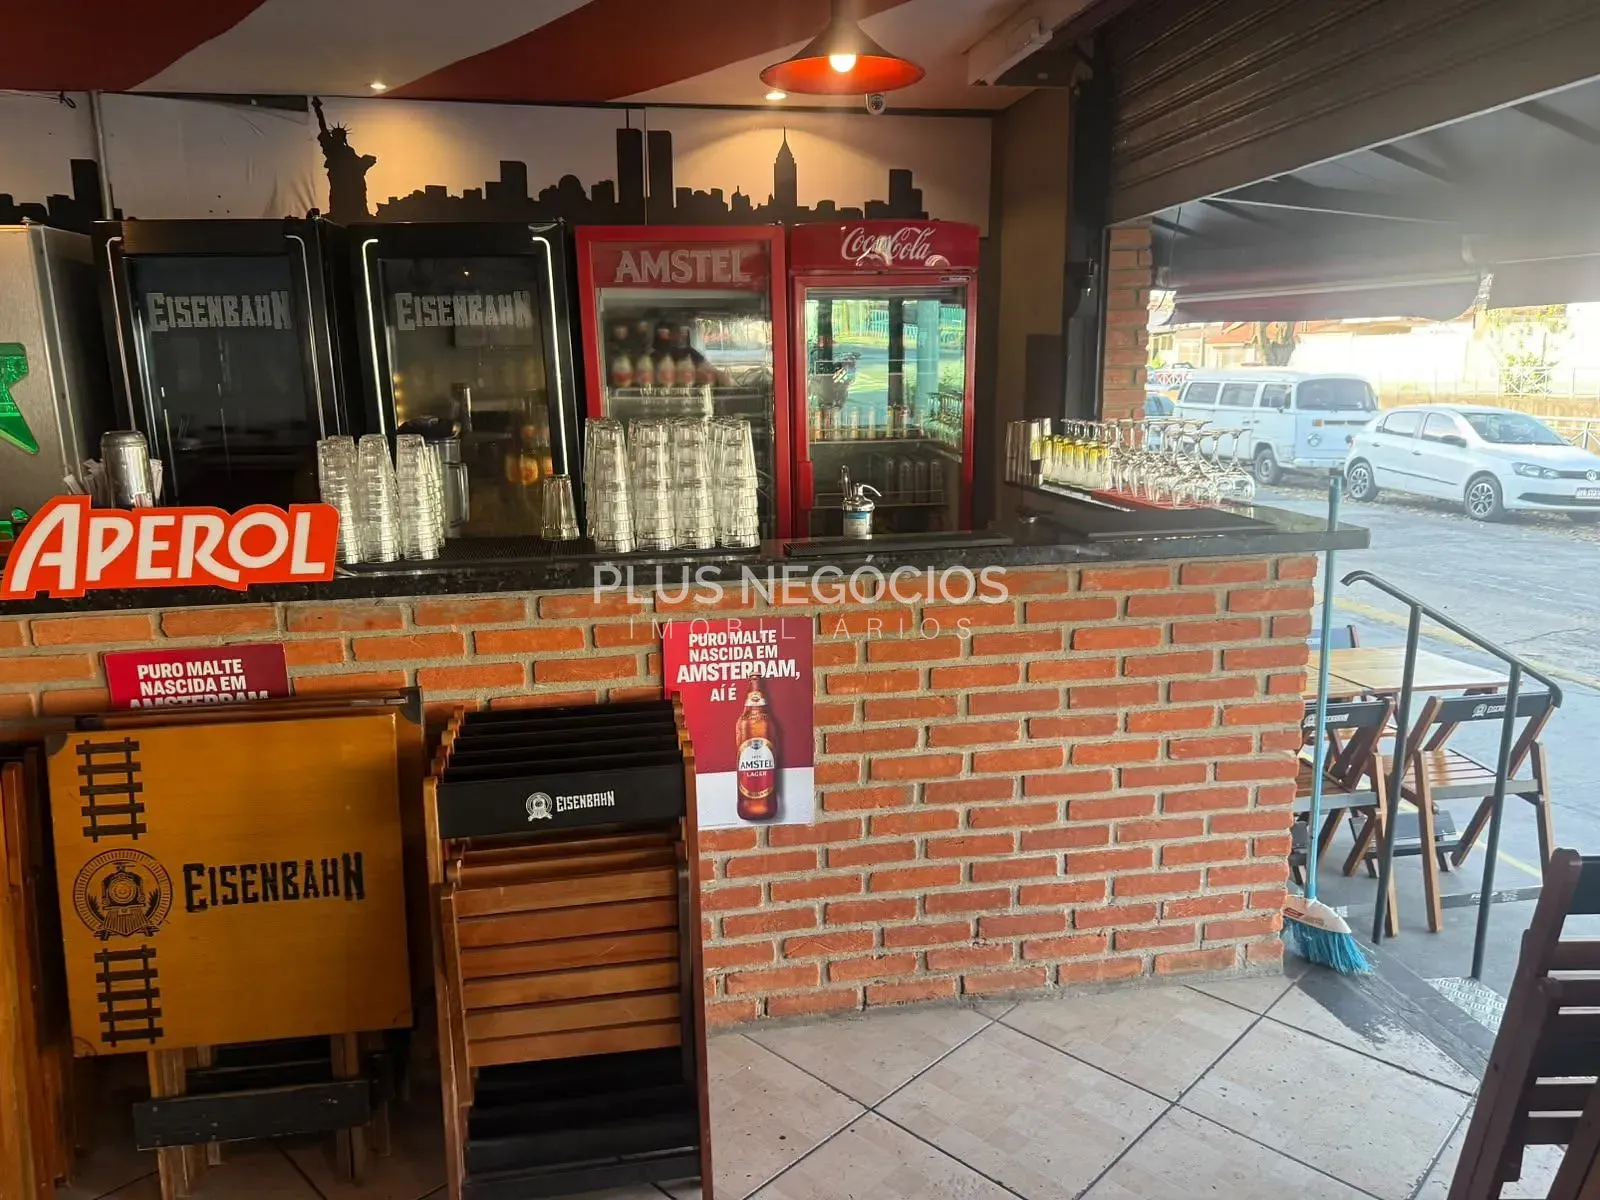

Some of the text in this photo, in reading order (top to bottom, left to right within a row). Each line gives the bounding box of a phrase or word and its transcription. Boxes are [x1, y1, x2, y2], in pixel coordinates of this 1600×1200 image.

[841, 226, 936, 261] CocaCola
[614, 249, 752, 283] AMSTEL
[146, 290, 292, 332] EISENBAHN
[395, 290, 533, 332] EISENBAHN
[10, 504, 325, 591] APEROL
[689, 629, 777, 648] PURO MALTE
[689, 644, 778, 663] NASCIDA EM
[137, 658, 243, 680] PURO MALTE
[677, 658, 801, 683] AMSTERDAM,
[140, 675, 247, 697] NASCIDA EM
[710, 682, 737, 702] AÍ É
[740, 759, 774, 769] AMSTEL
[555, 790, 615, 812] EISENBAHN
[183, 852, 365, 913] EISENBAHN
